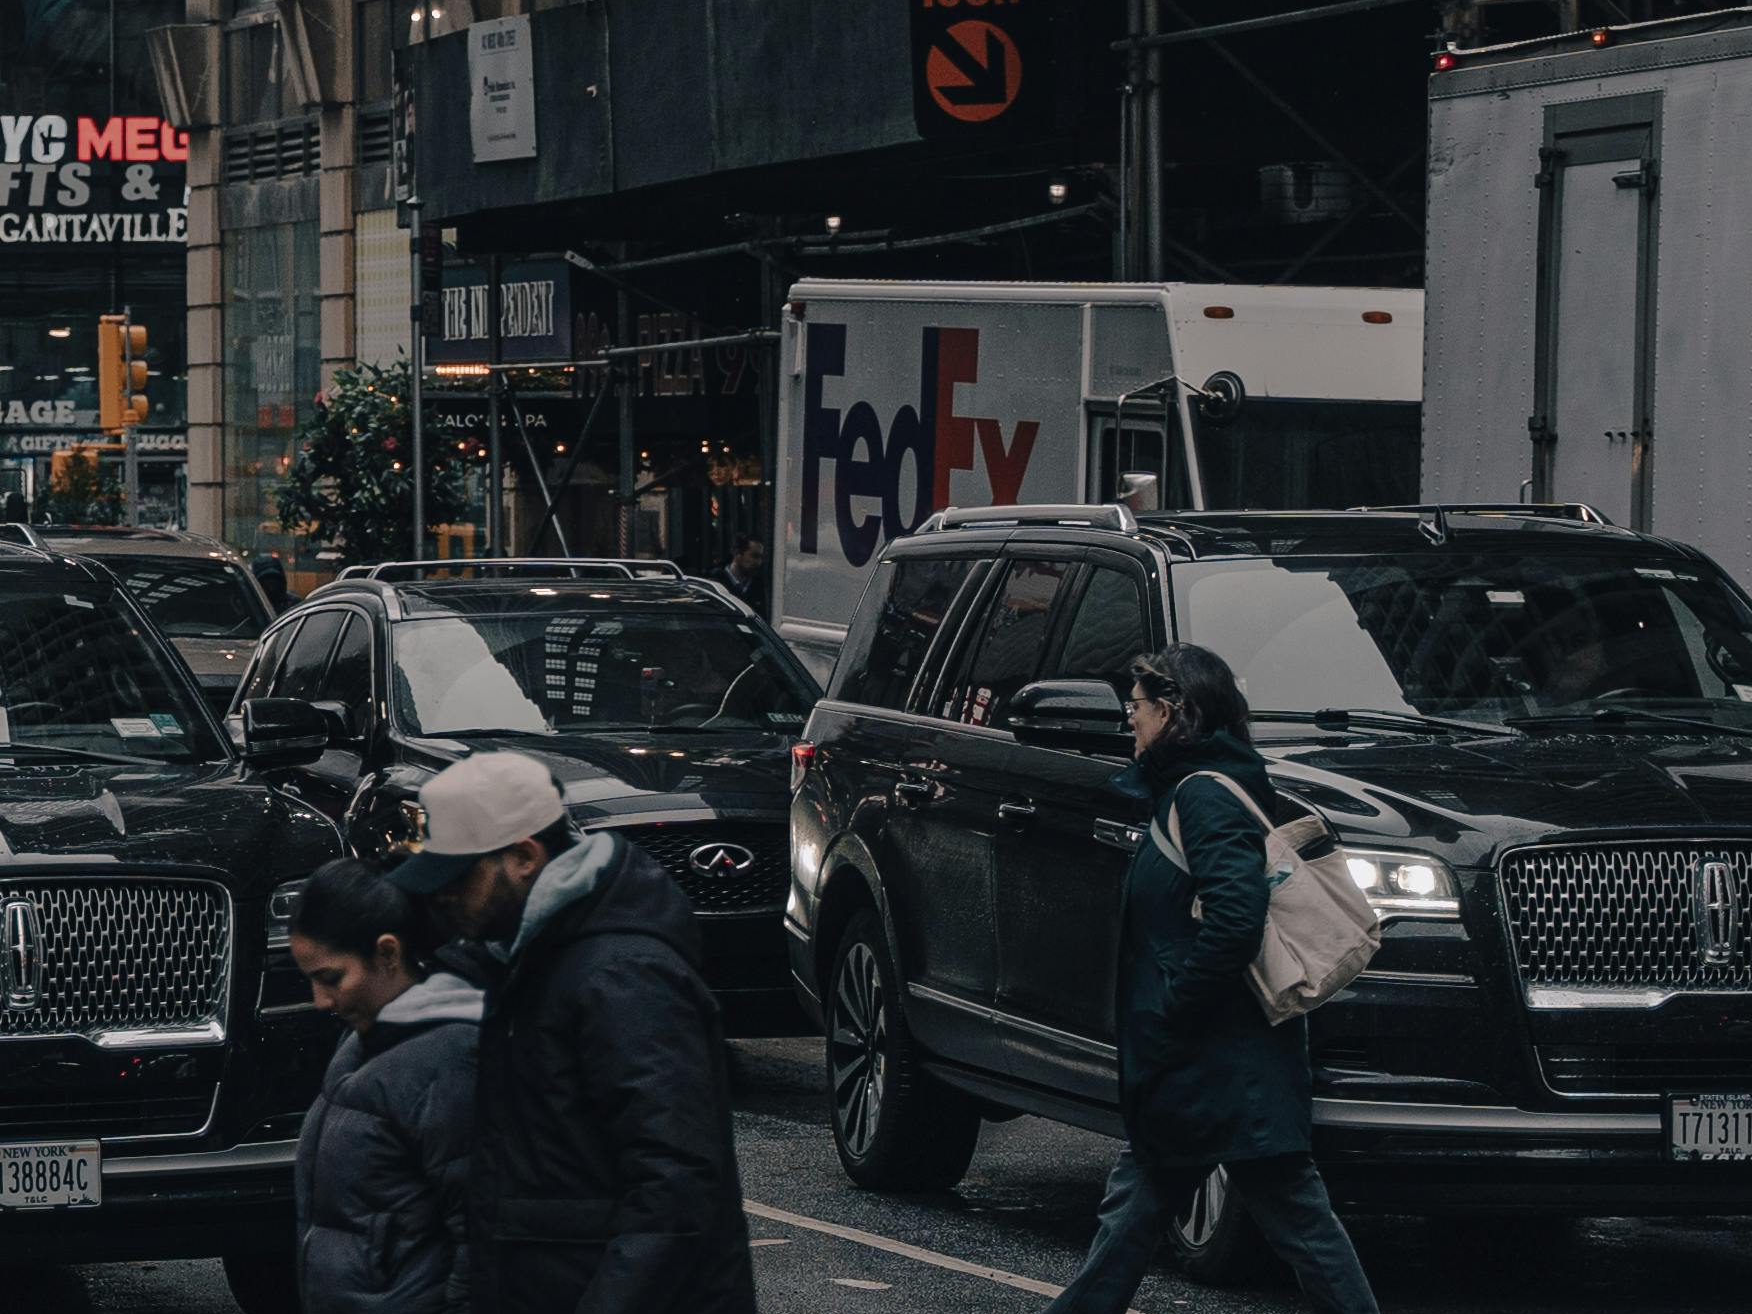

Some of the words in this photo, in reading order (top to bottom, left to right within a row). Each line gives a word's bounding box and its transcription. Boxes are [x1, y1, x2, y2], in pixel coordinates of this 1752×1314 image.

[121, 163, 161, 202] &
[800, 323, 1040, 567] FedEx
[3, 1148, 30, 1159] NEW
[35, 1146, 67, 1157] YORK
